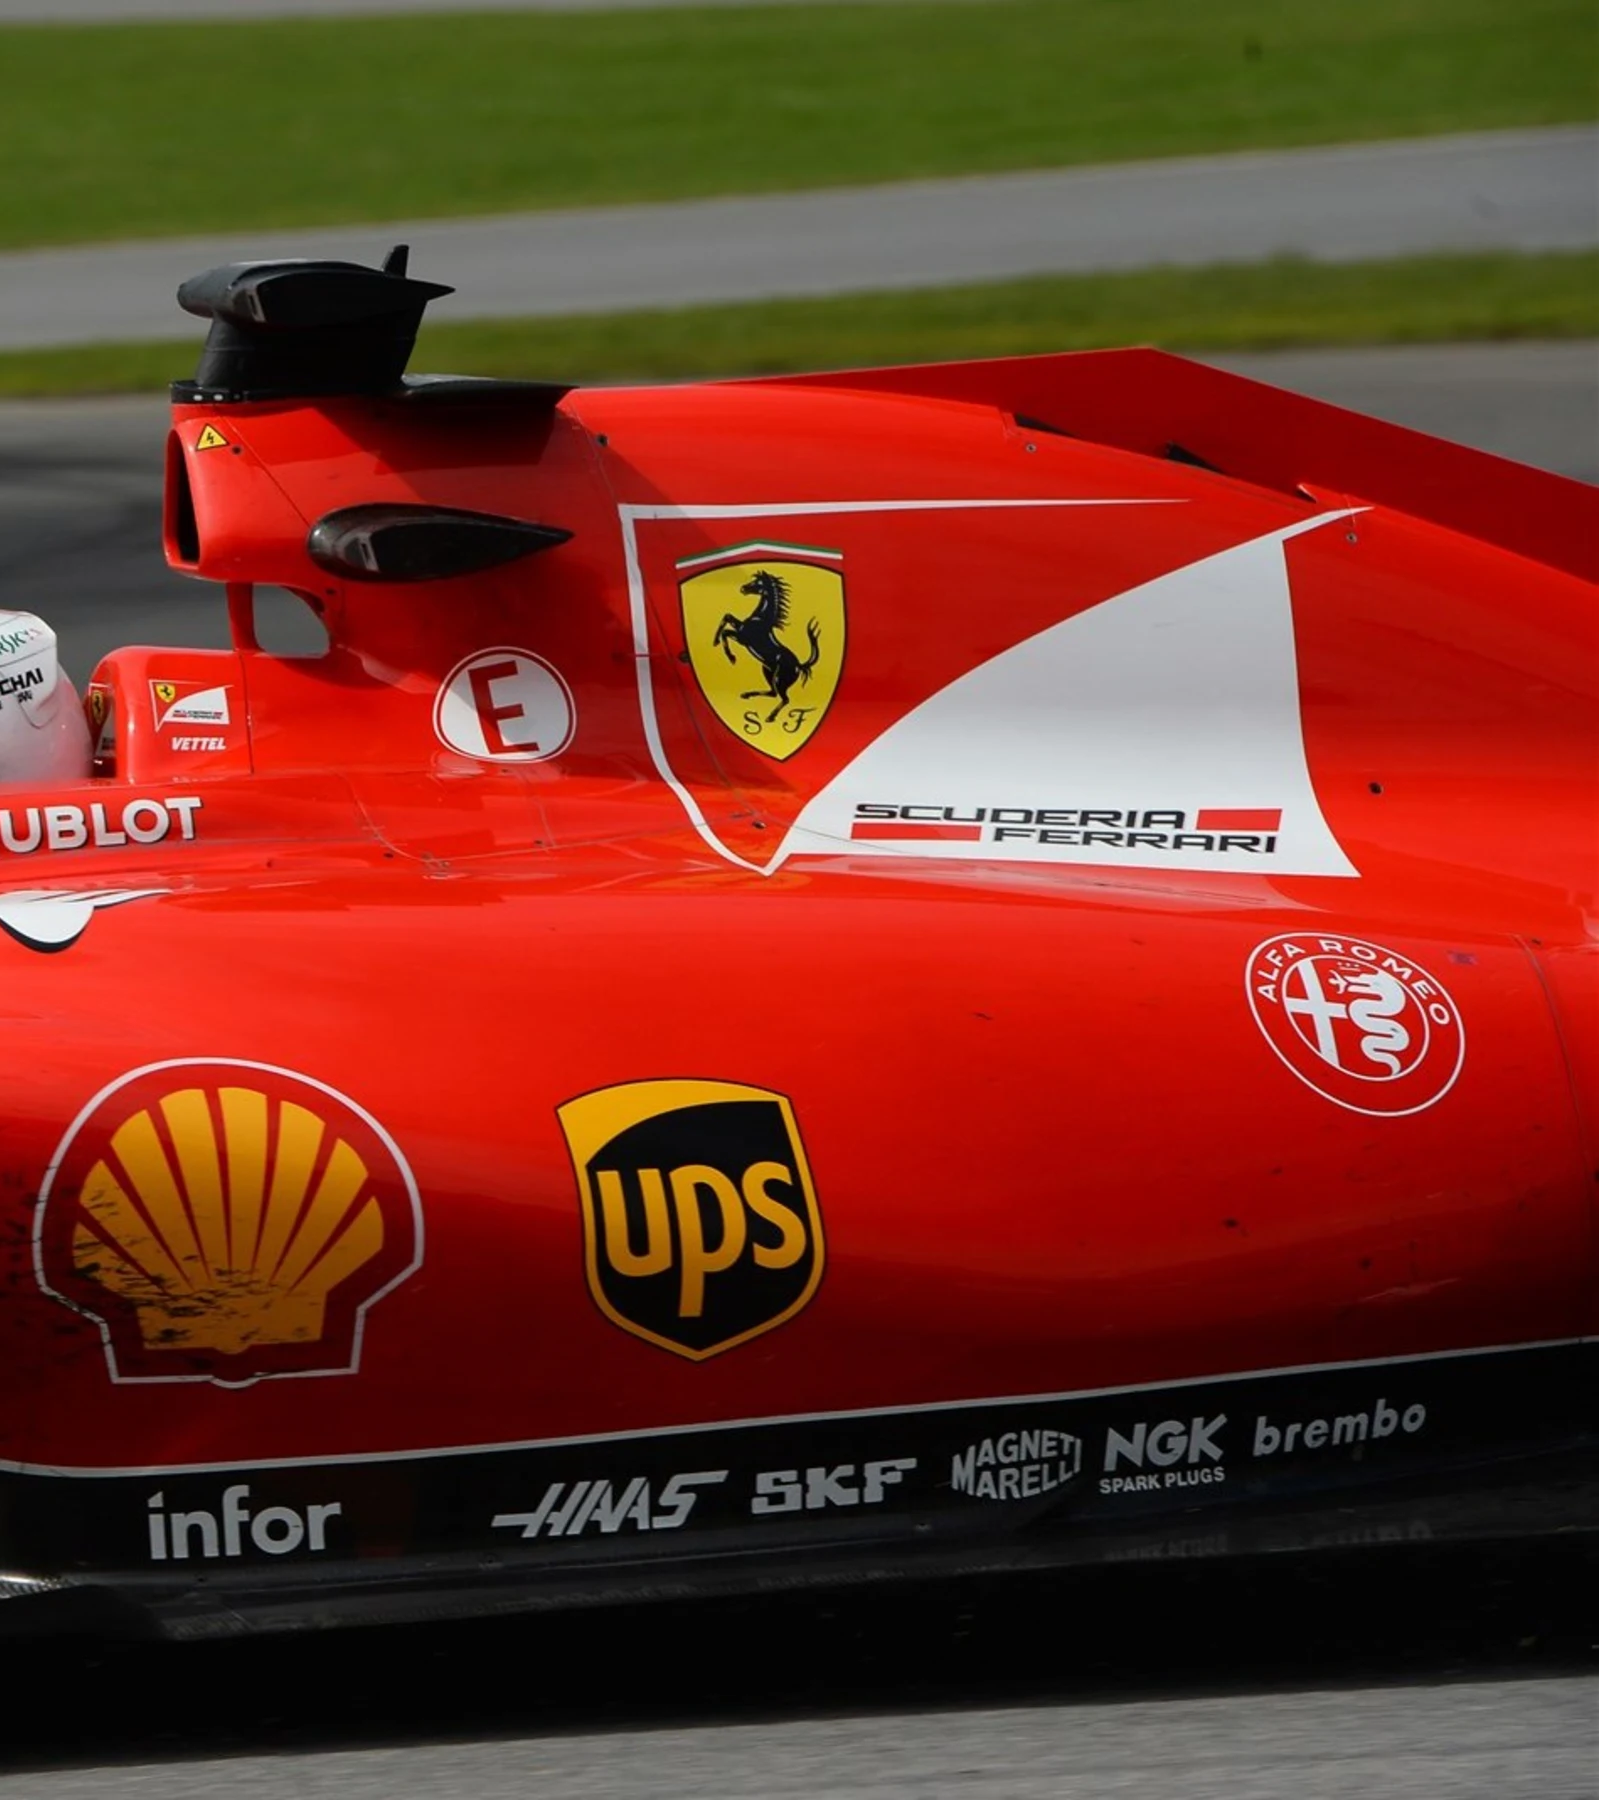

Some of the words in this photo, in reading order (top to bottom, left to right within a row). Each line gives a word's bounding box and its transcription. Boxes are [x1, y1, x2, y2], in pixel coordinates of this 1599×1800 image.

[467, 660, 540, 756] E
[171, 736, 227, 751] VETTEL
[854, 803, 1186, 829] SCUDERIA
[992, 827, 1277, 853] FERRARI
[1257, 942, 1305, 1003] ALFA
[1319, 939, 1450, 1025] ROMEO
[1103, 1413, 1228, 1472] NGK
[1253, 1397, 1427, 1457] brembo
[492, 1470, 729, 1539] HAAS
[751, 1457, 917, 1515] SKF
[1100, 1474, 1161, 1494] SPARK
[1165, 1466, 1225, 1488] PLUGS
[148, 1484, 341, 1560] infor
